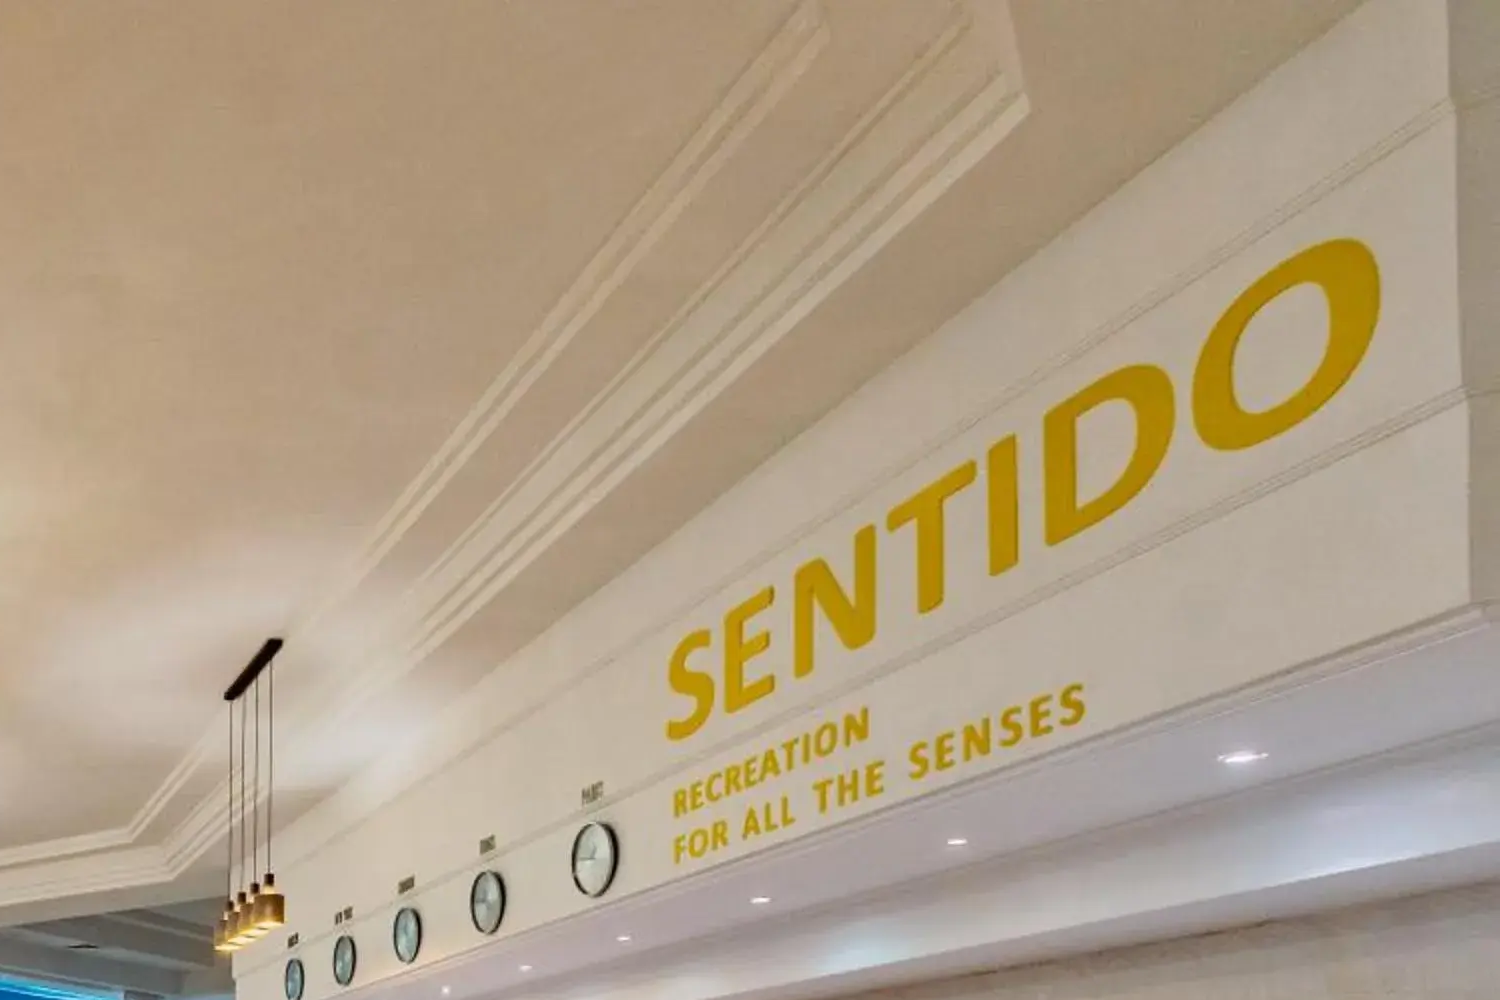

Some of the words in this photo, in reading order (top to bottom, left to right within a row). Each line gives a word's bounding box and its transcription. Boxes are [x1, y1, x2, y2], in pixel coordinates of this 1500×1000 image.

[665, 237, 1382, 743] SENTIDO
[672, 706, 870, 819] RECREATION
[672, 820, 729, 865] FOR
[741, 796, 797, 841] ALL
[812, 760, 886, 814] THE
[908, 682, 1088, 781] SENSES
